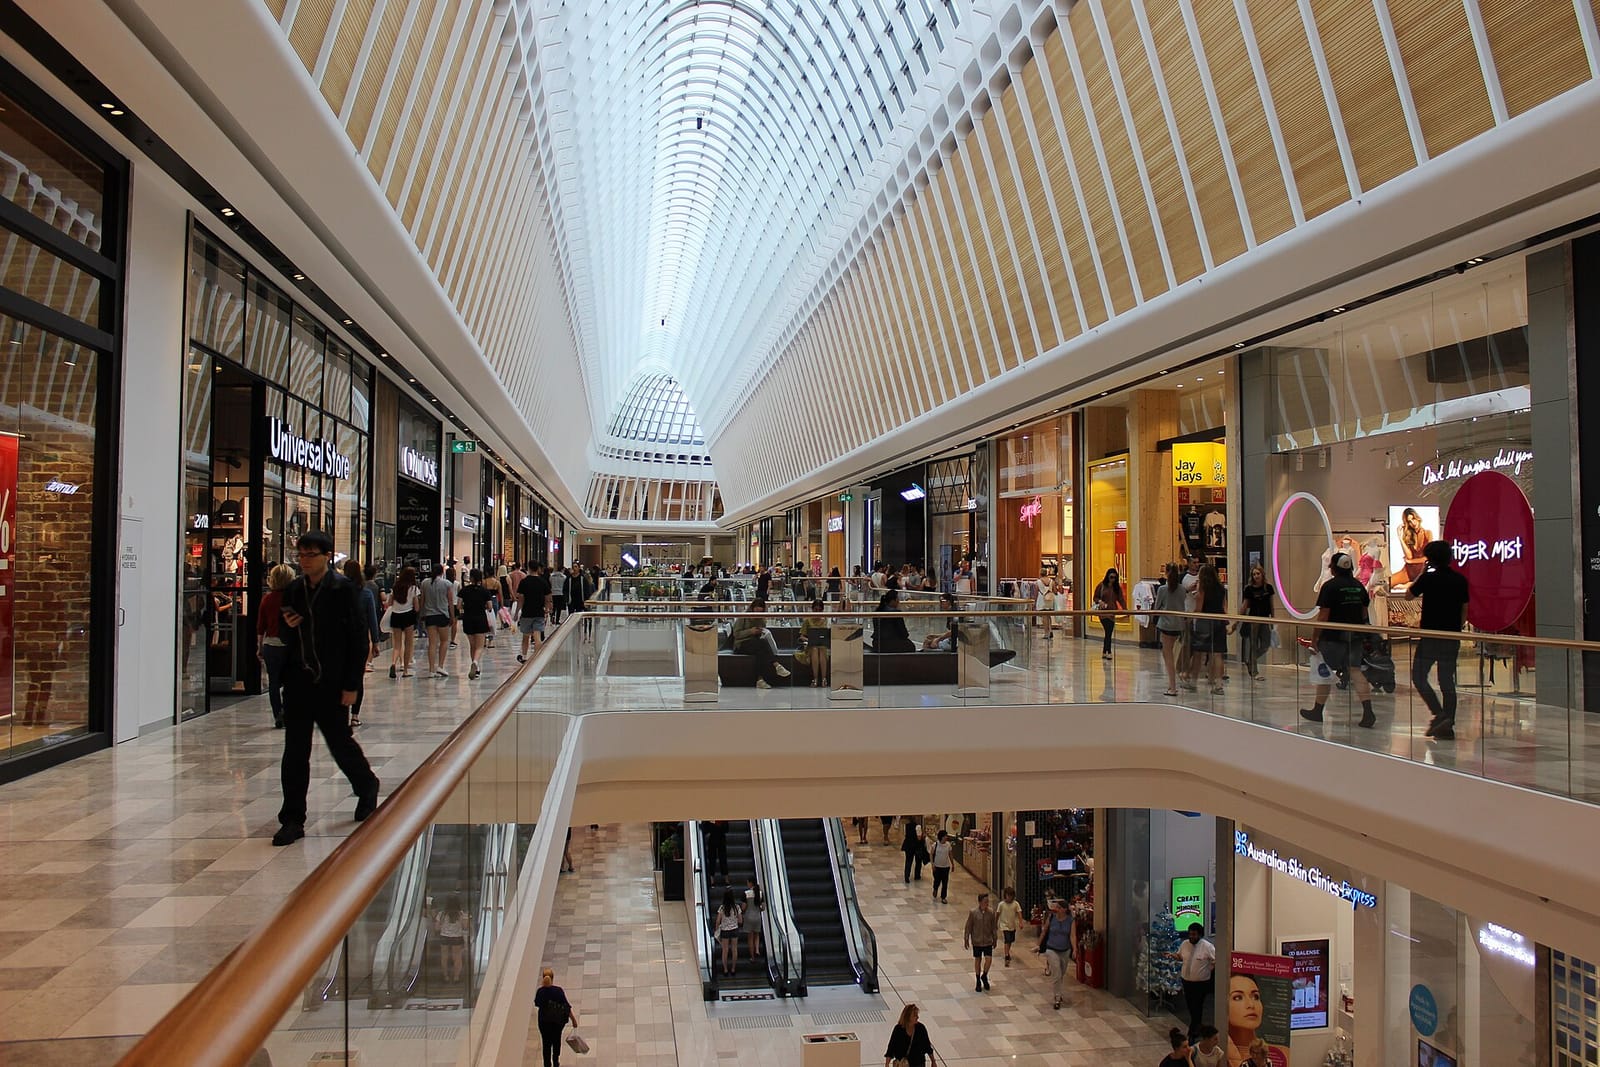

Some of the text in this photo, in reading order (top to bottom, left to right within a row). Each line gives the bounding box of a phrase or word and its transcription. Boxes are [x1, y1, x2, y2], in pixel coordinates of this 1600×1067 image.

[271, 416, 323, 473] Universal
[325, 441, 350, 480] Store
[1175, 459, 1196, 472] Jay
[1445, 459, 1462, 480] let
[1175, 471, 1203, 484] Jays
[1247, 842, 1377, 910] Australian Skin Clinics Express
[1176, 895, 1200, 903] CREATE
